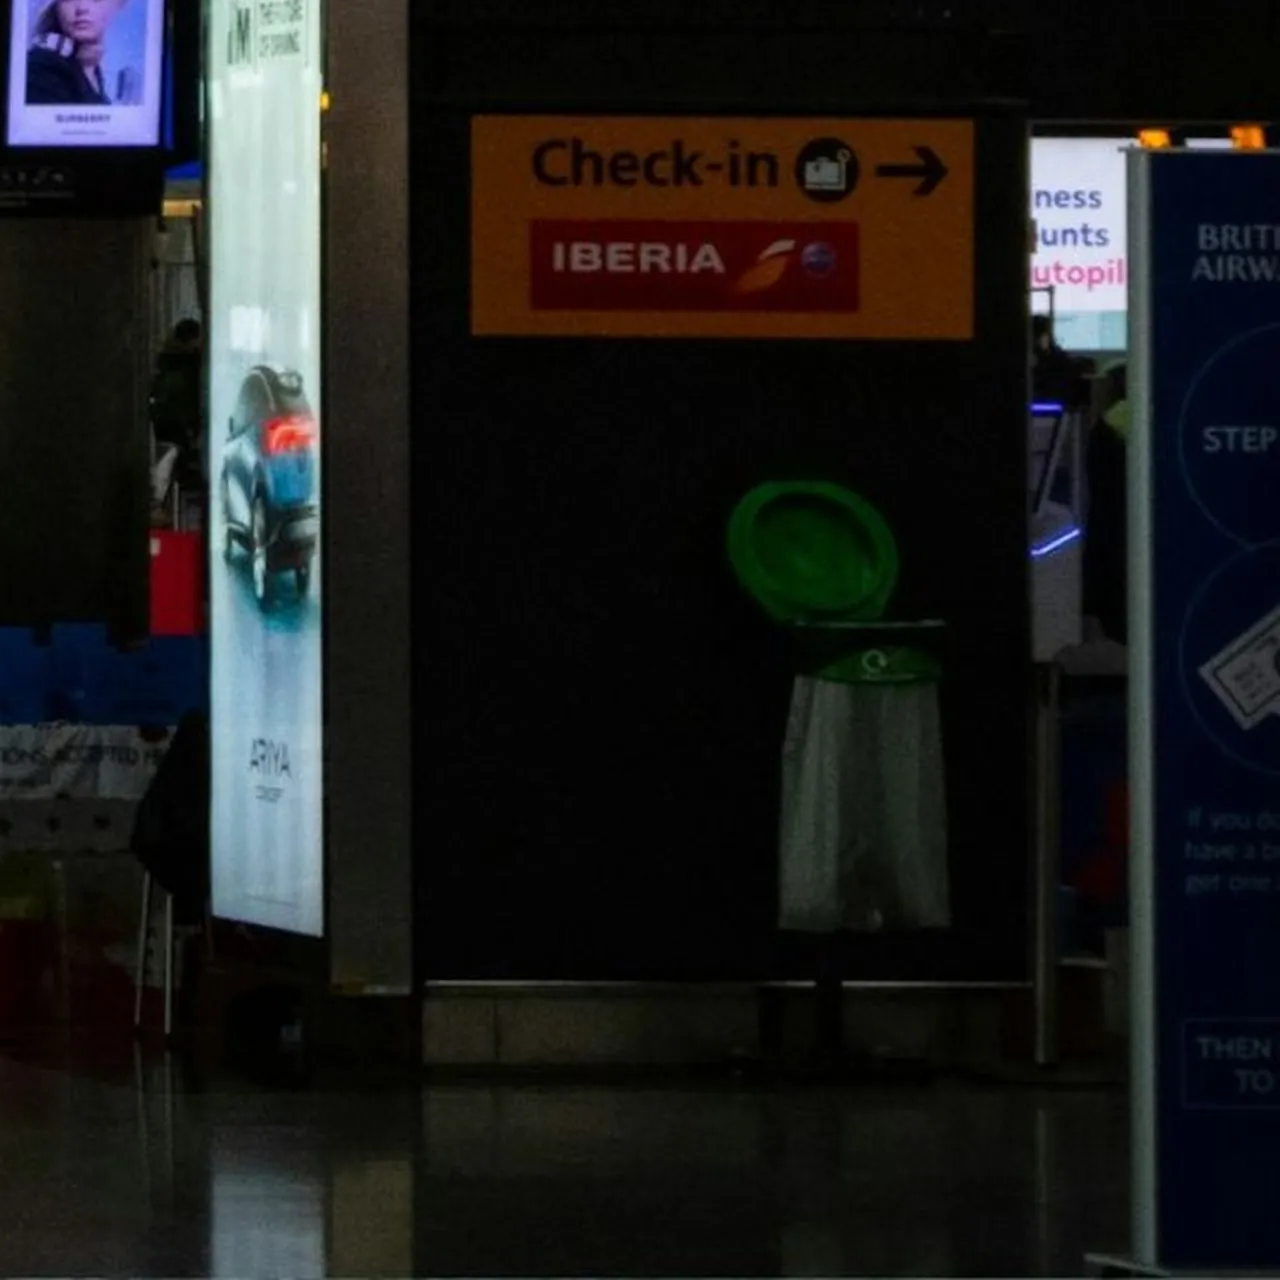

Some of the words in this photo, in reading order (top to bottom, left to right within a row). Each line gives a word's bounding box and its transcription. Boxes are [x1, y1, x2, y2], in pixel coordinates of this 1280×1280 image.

[531, 136, 779, 189] Check-in
[1035, 189, 1102, 210] ness
[1041, 223, 1110, 248] unts
[553, 241, 727, 273] IBERIA
[1203, 425, 1278, 454] STEP
[1196, 1035, 1273, 1062] THEN
[1233, 1067, 1277, 1097] TO
